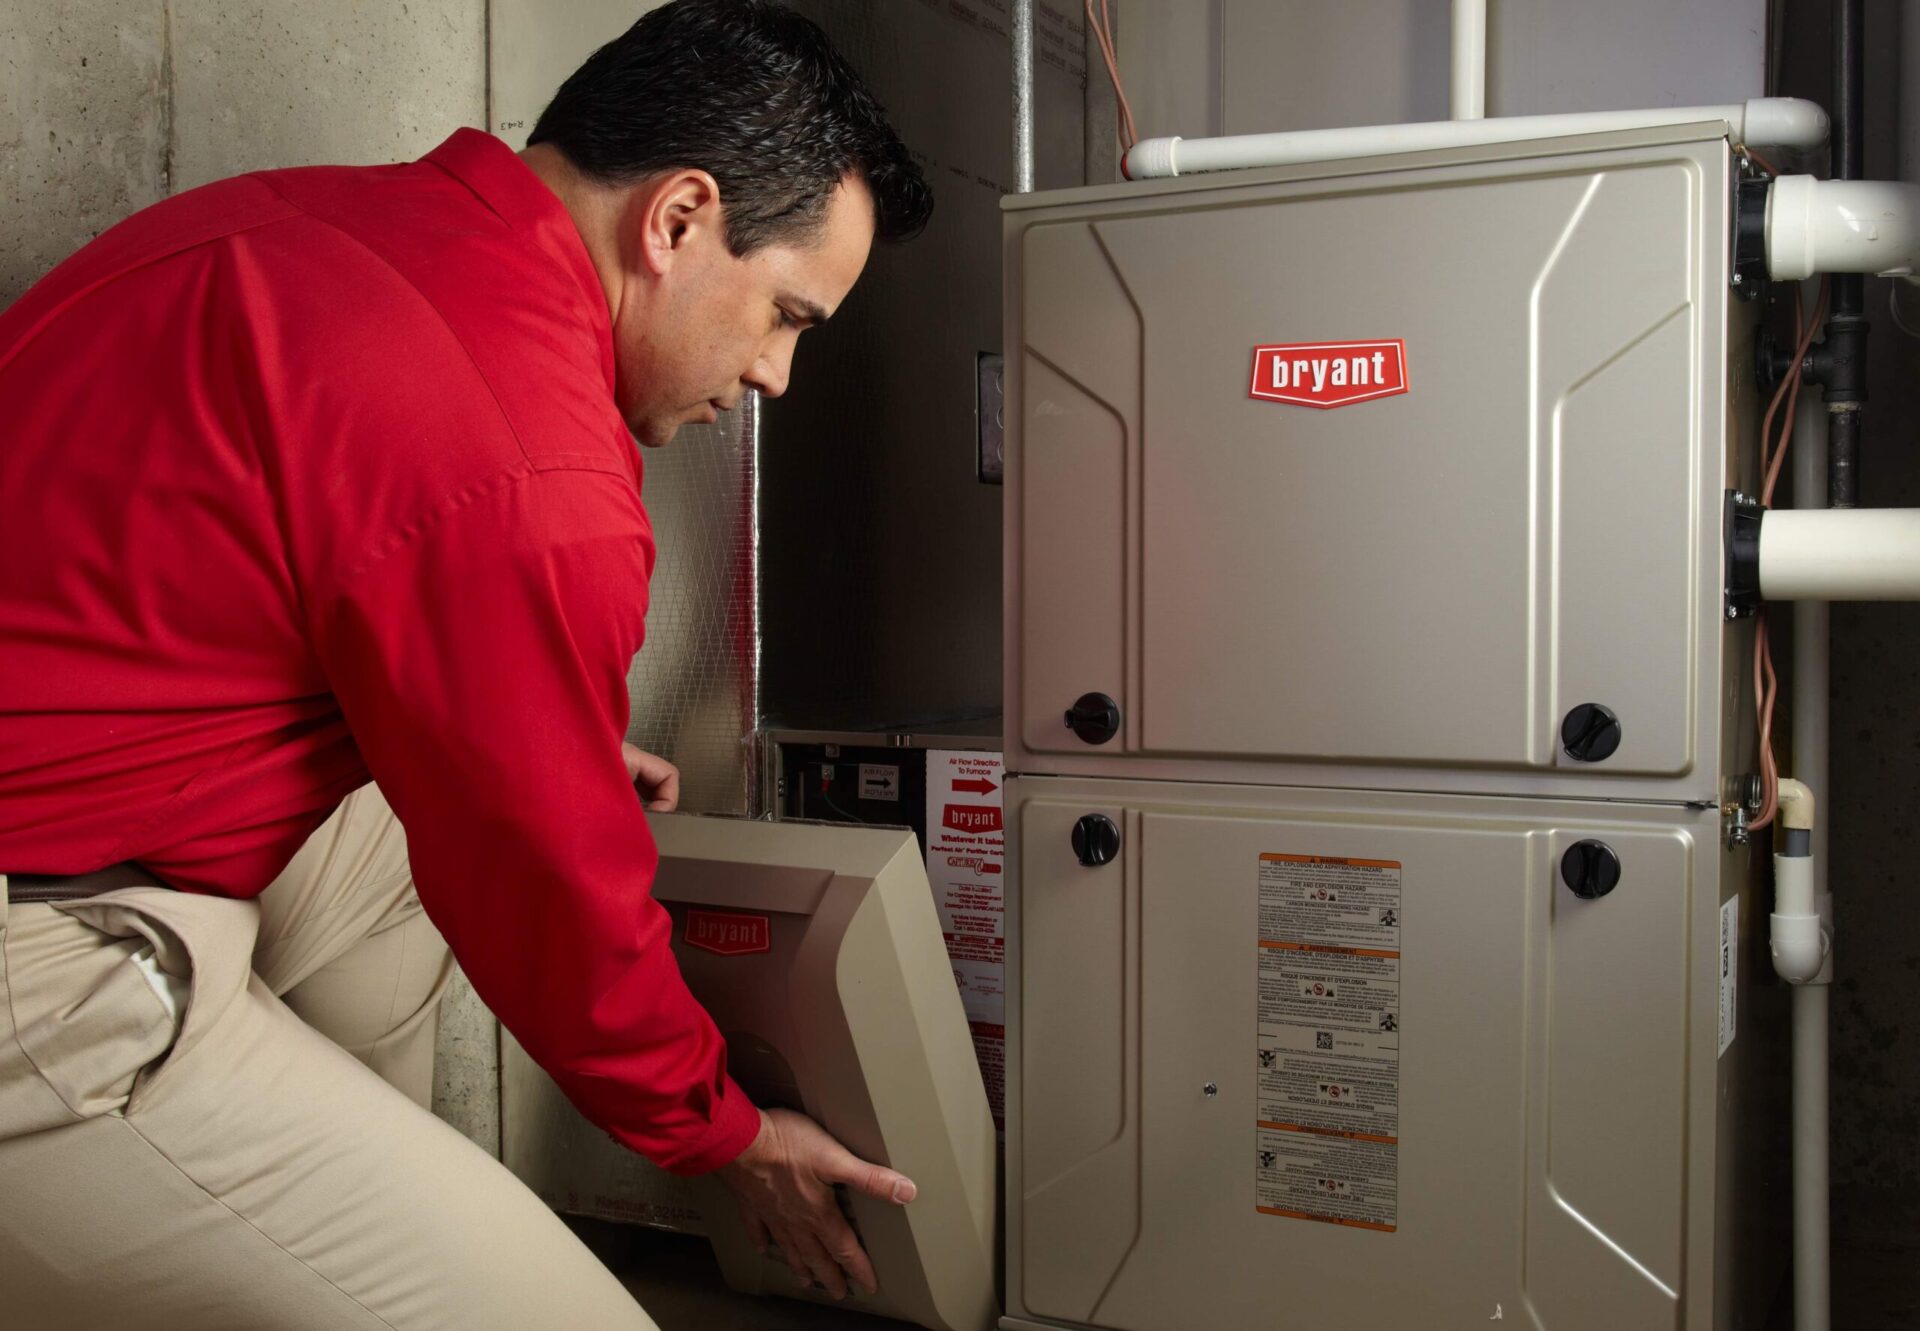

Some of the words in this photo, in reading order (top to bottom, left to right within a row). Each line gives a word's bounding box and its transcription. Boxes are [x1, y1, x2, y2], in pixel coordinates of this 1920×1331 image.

[1272, 351, 1385, 393] bryant
[973, 759, 1001, 767] Direction
[966, 768, 992, 776] Furnace
[952, 809, 995, 826] bryant
[941, 834, 976, 844] Whatever
[698, 917, 758, 944] bryant
